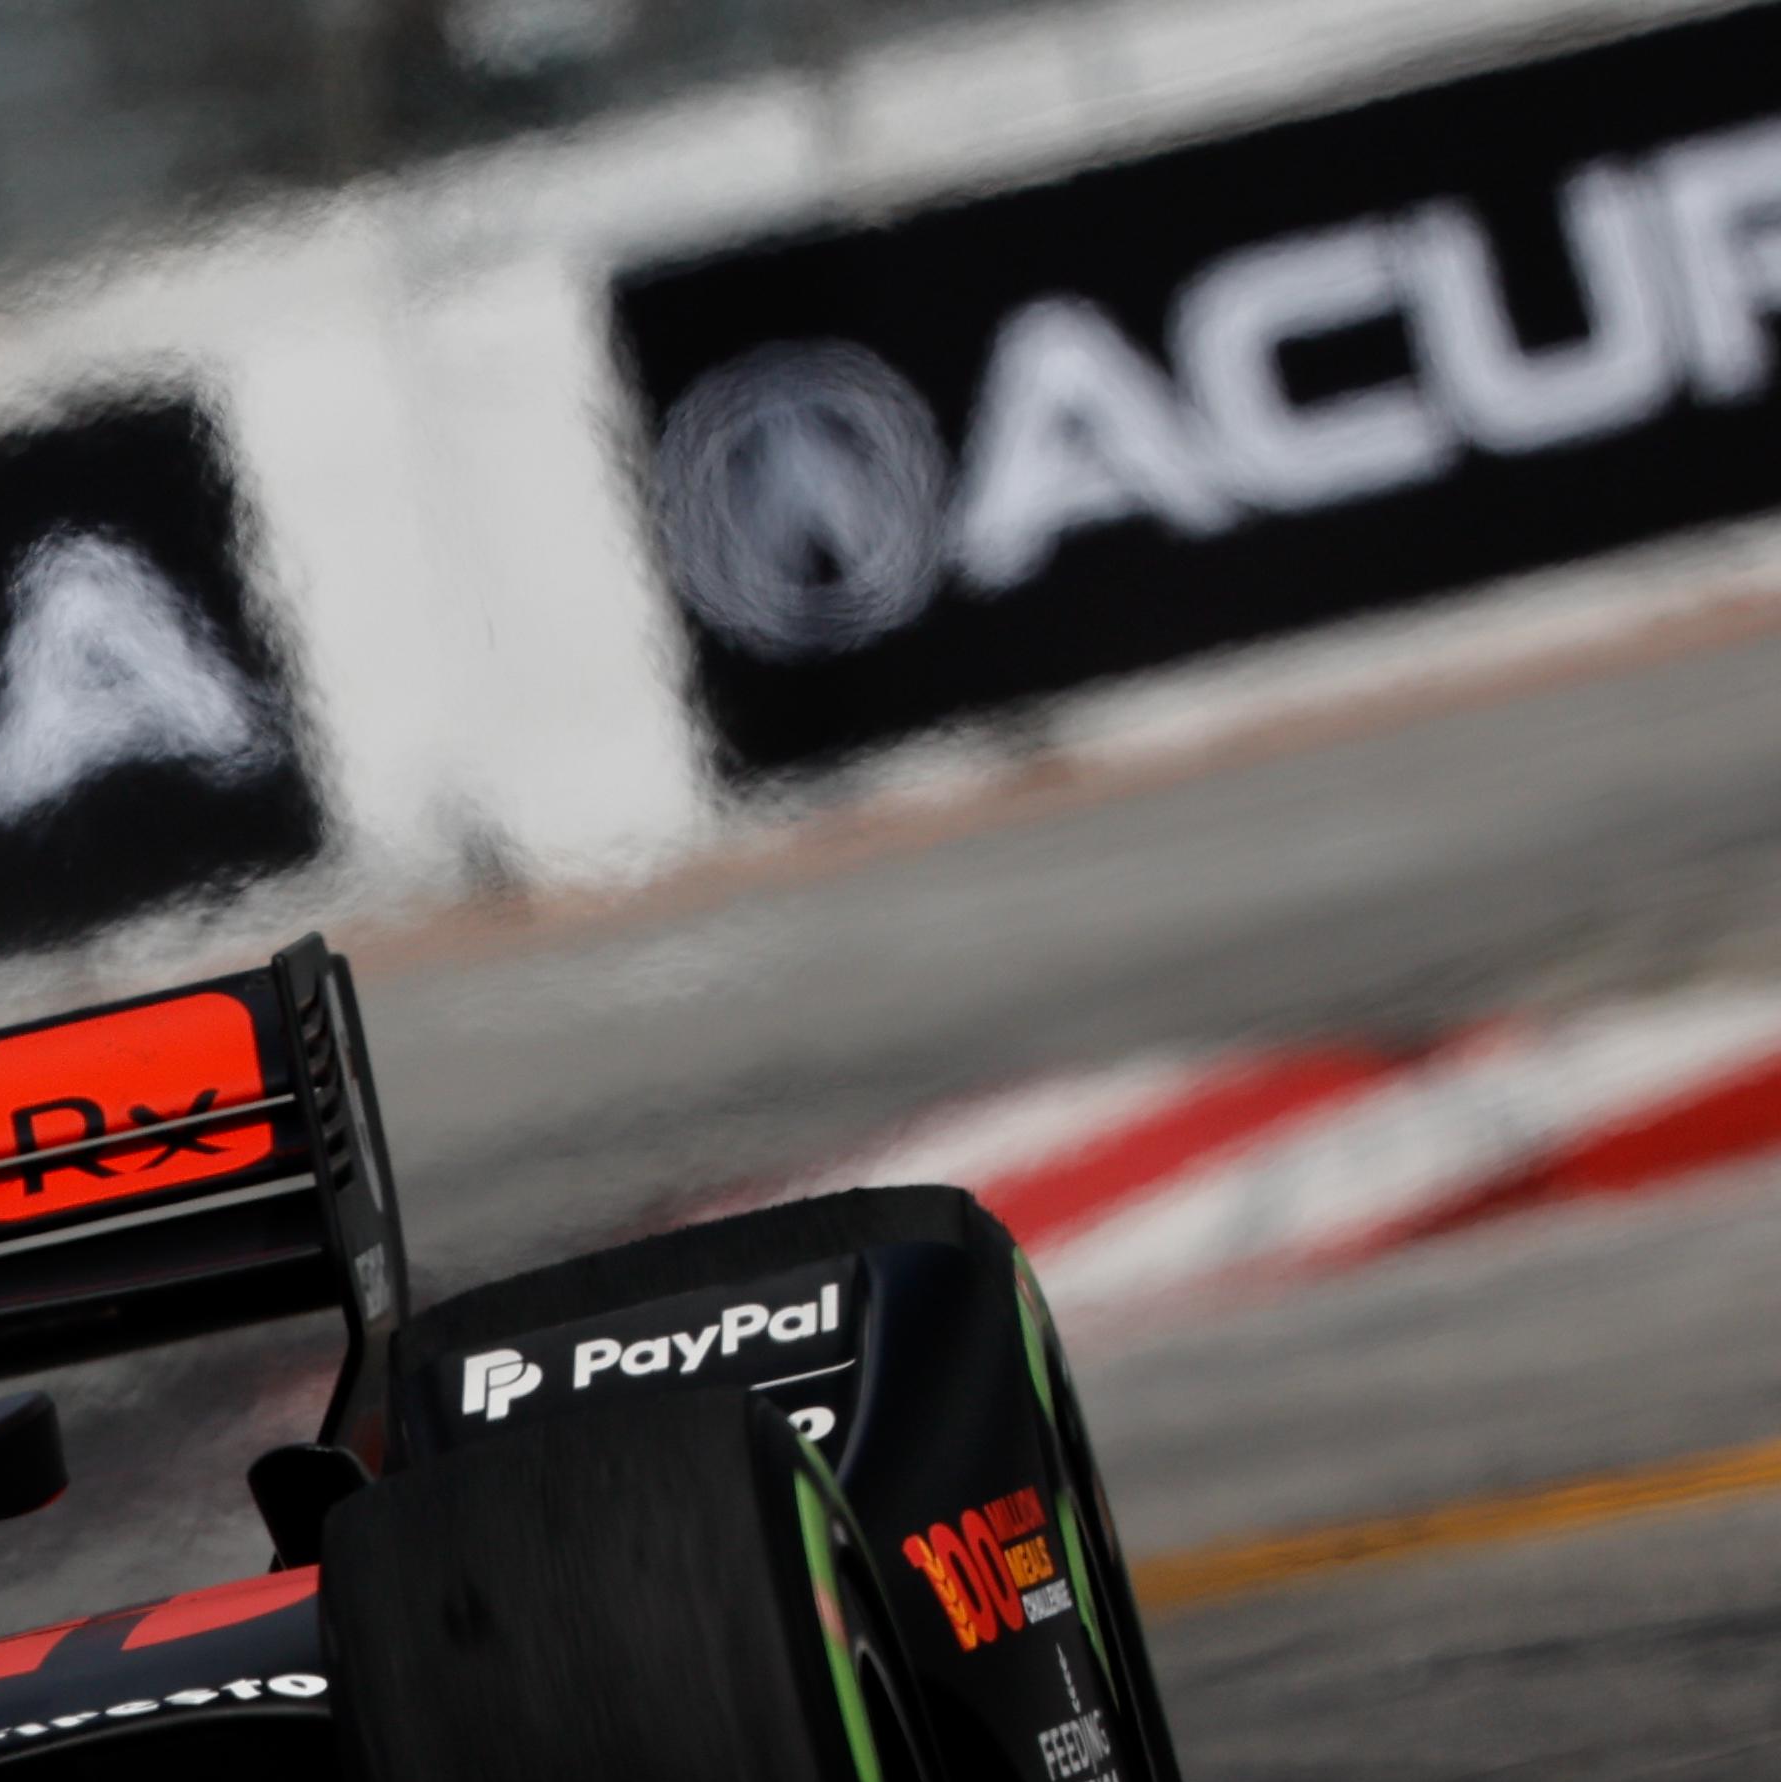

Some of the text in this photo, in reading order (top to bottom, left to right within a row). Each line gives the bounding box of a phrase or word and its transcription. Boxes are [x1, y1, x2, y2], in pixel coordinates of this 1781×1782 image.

[13, 1088, 233, 1196] Rx
[573, 1284, 839, 1390] PayPal
[1037, 1708, 1111, 1782] FEEDING
